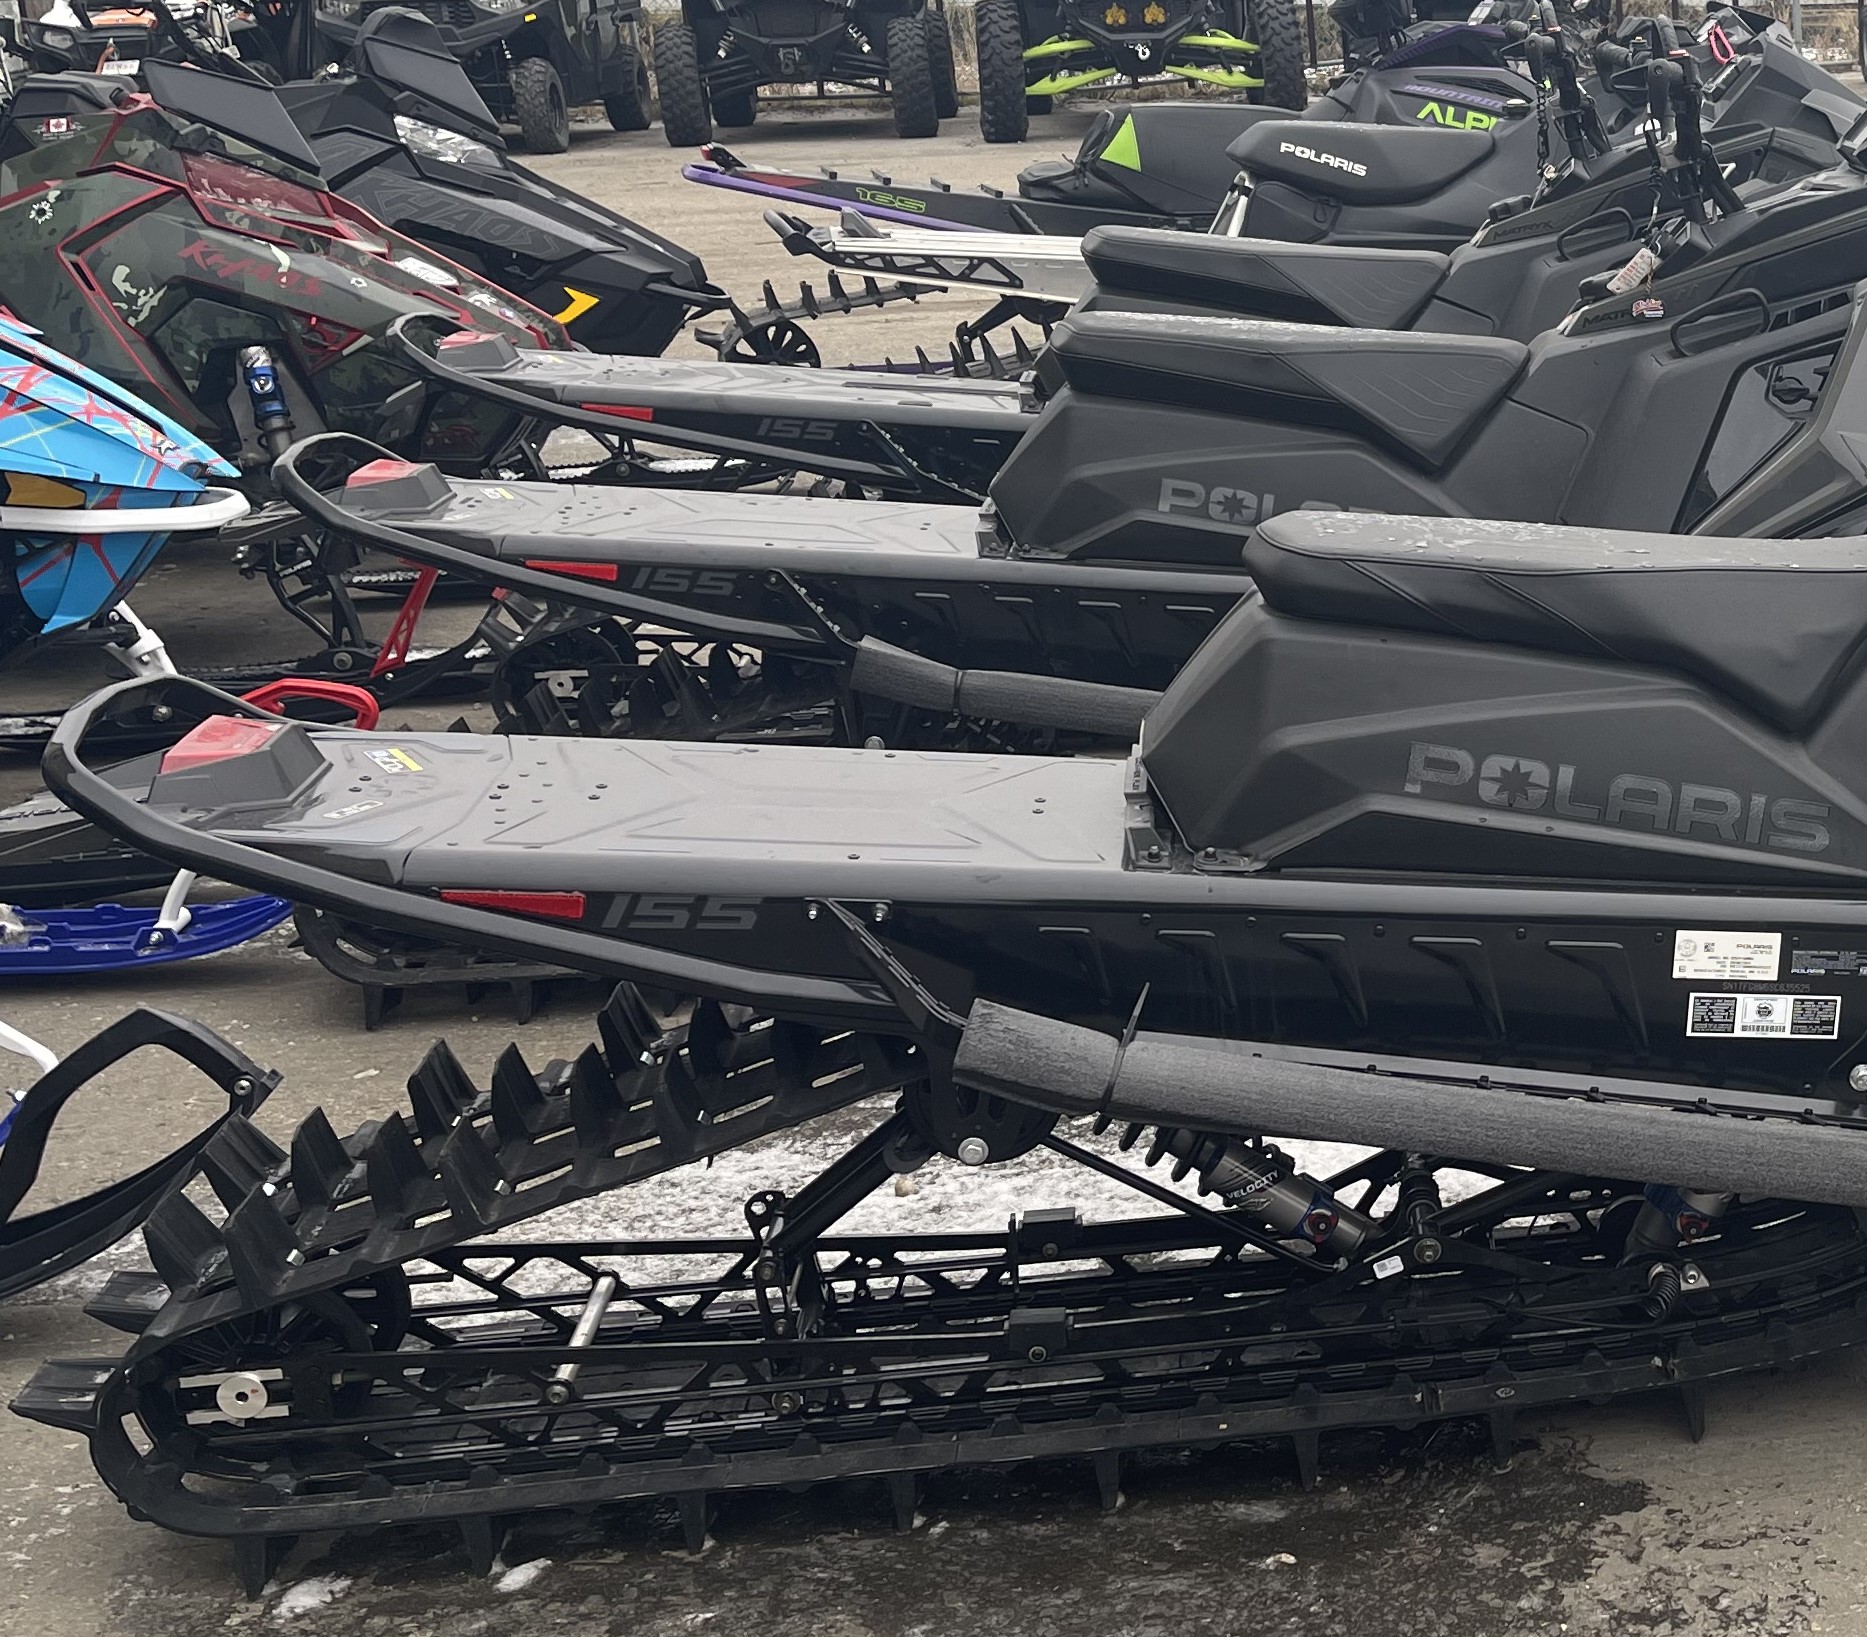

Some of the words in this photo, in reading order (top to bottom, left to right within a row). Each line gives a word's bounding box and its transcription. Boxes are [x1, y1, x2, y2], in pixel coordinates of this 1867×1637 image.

[1279, 141, 1368, 177] POLARIS
[855, 187, 927, 213] 165
[1492, 220, 1554, 241] MATRYX
[756, 417, 838, 441] 155
[631, 566, 738, 597] 155
[1402, 740, 1832, 854] POLARIS
[600, 892, 763, 930] 155
[1225, 1169, 1279, 1199] VELOCITY
